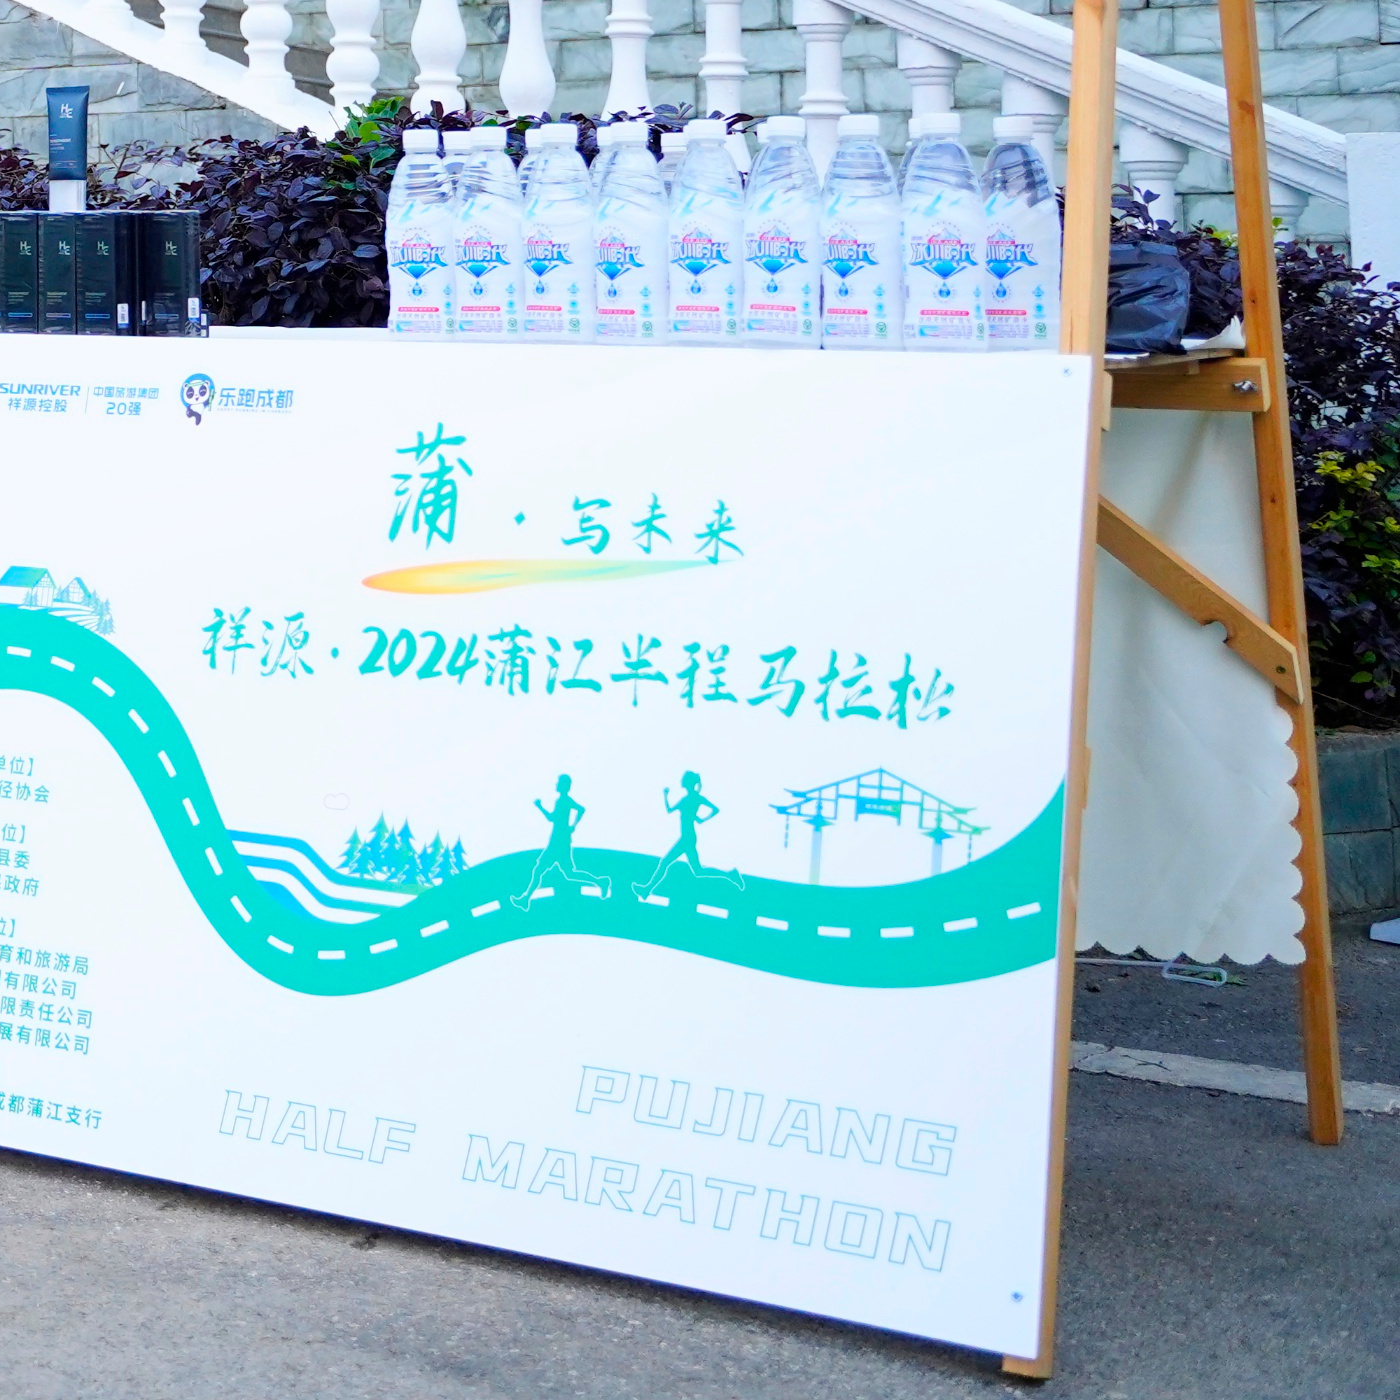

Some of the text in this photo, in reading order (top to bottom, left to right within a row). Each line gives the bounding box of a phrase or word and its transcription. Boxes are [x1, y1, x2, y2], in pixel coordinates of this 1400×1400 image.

[0, 383, 81, 396] SUNRIVER
[93, 386, 160, 399] 中国旅游集团
[218, 387, 294, 408] 乐跑成都
[8, 397, 68, 413] 祥源控股
[106, 402, 142, 416] 20强
[575, 1066, 957, 1176] PUJIANG
[218, 1089, 952, 1272] HALF MARATHON
